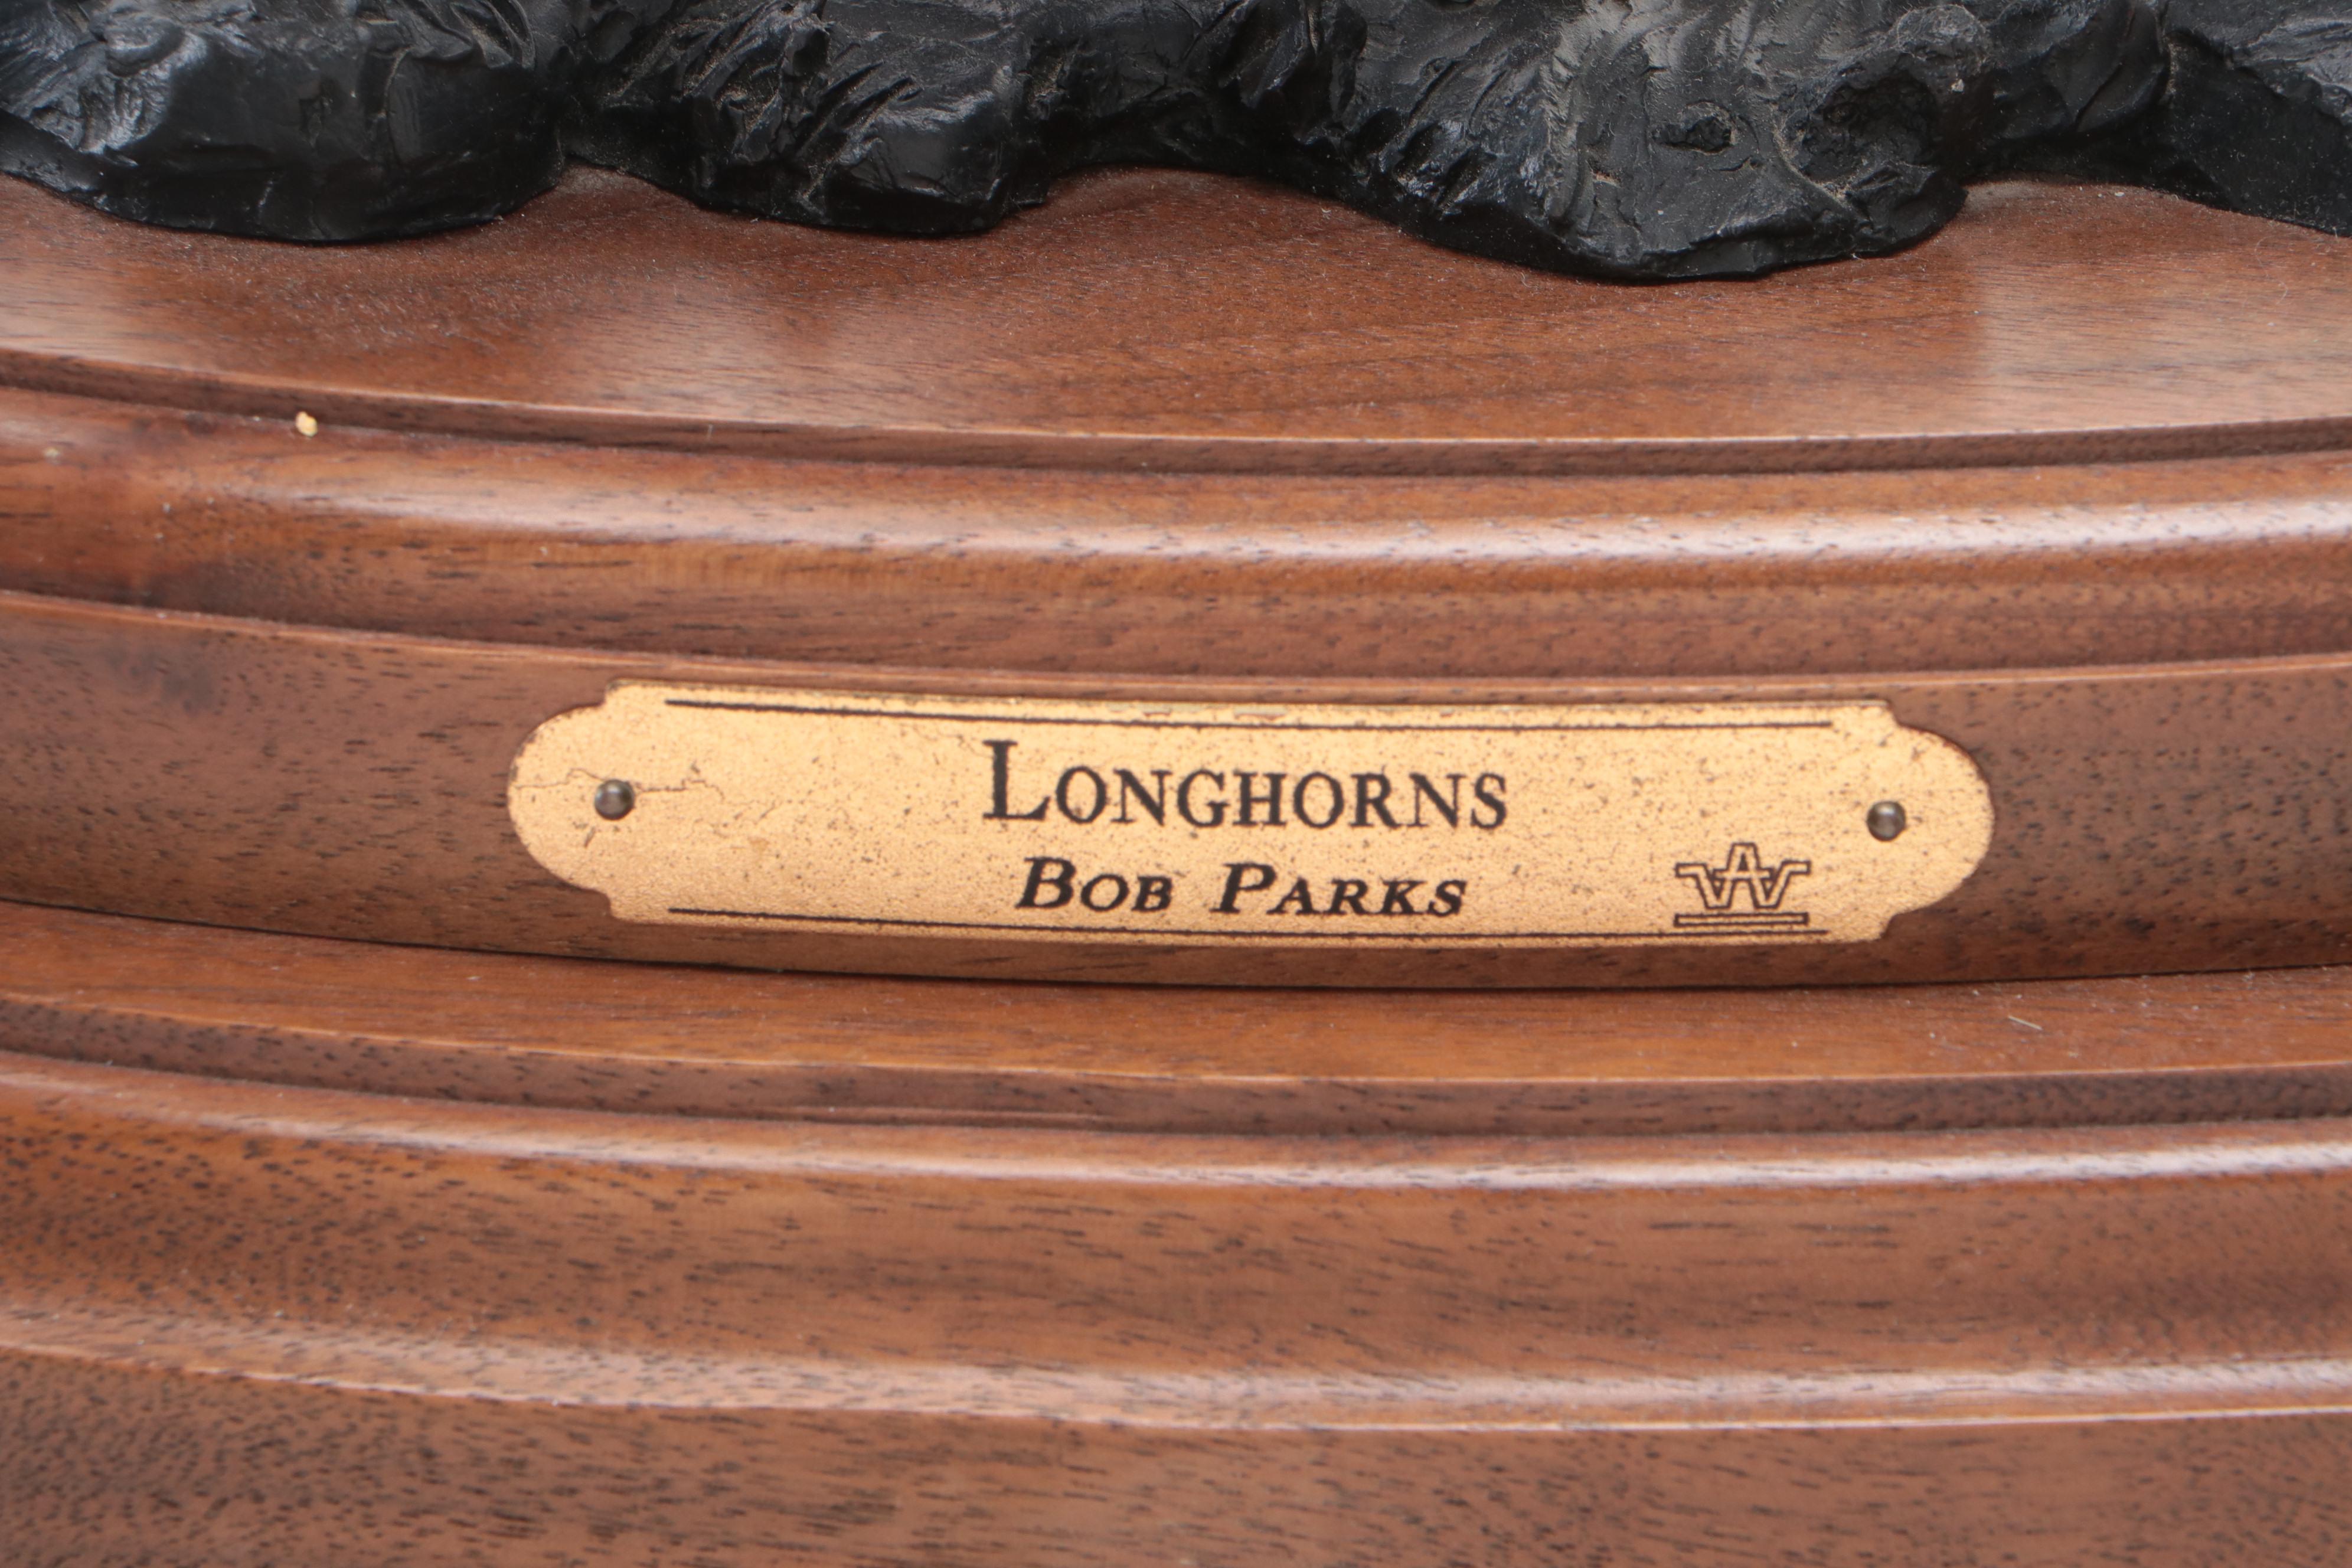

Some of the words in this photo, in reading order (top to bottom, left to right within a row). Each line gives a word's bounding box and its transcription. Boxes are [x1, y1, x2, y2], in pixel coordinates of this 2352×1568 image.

[982, 740, 1508, 830] LONGHORNS
[1015, 856, 1173, 913] BOB
[1209, 862, 1467, 917] PARKS
